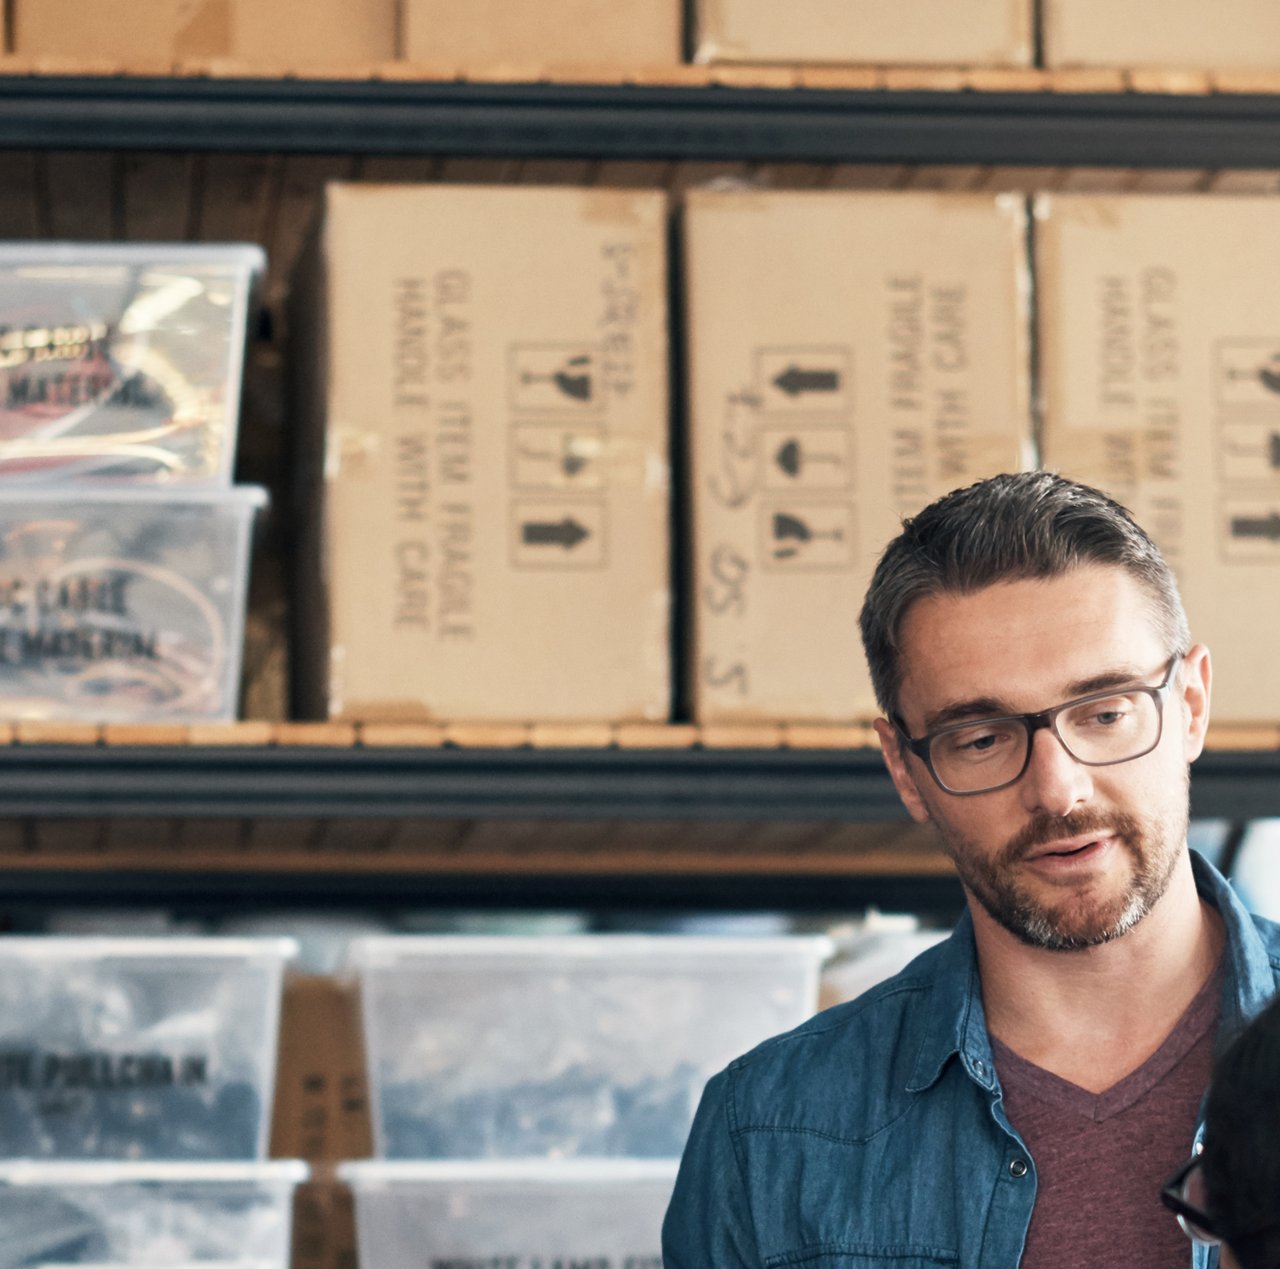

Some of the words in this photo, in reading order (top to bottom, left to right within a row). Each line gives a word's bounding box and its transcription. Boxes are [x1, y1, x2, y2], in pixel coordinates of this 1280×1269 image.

[393, 276, 429, 408] HANDLE
[395, 431, 429, 523] WITH
[434, 400, 474, 485] ITEM
[395, 539, 430, 633] CARE
